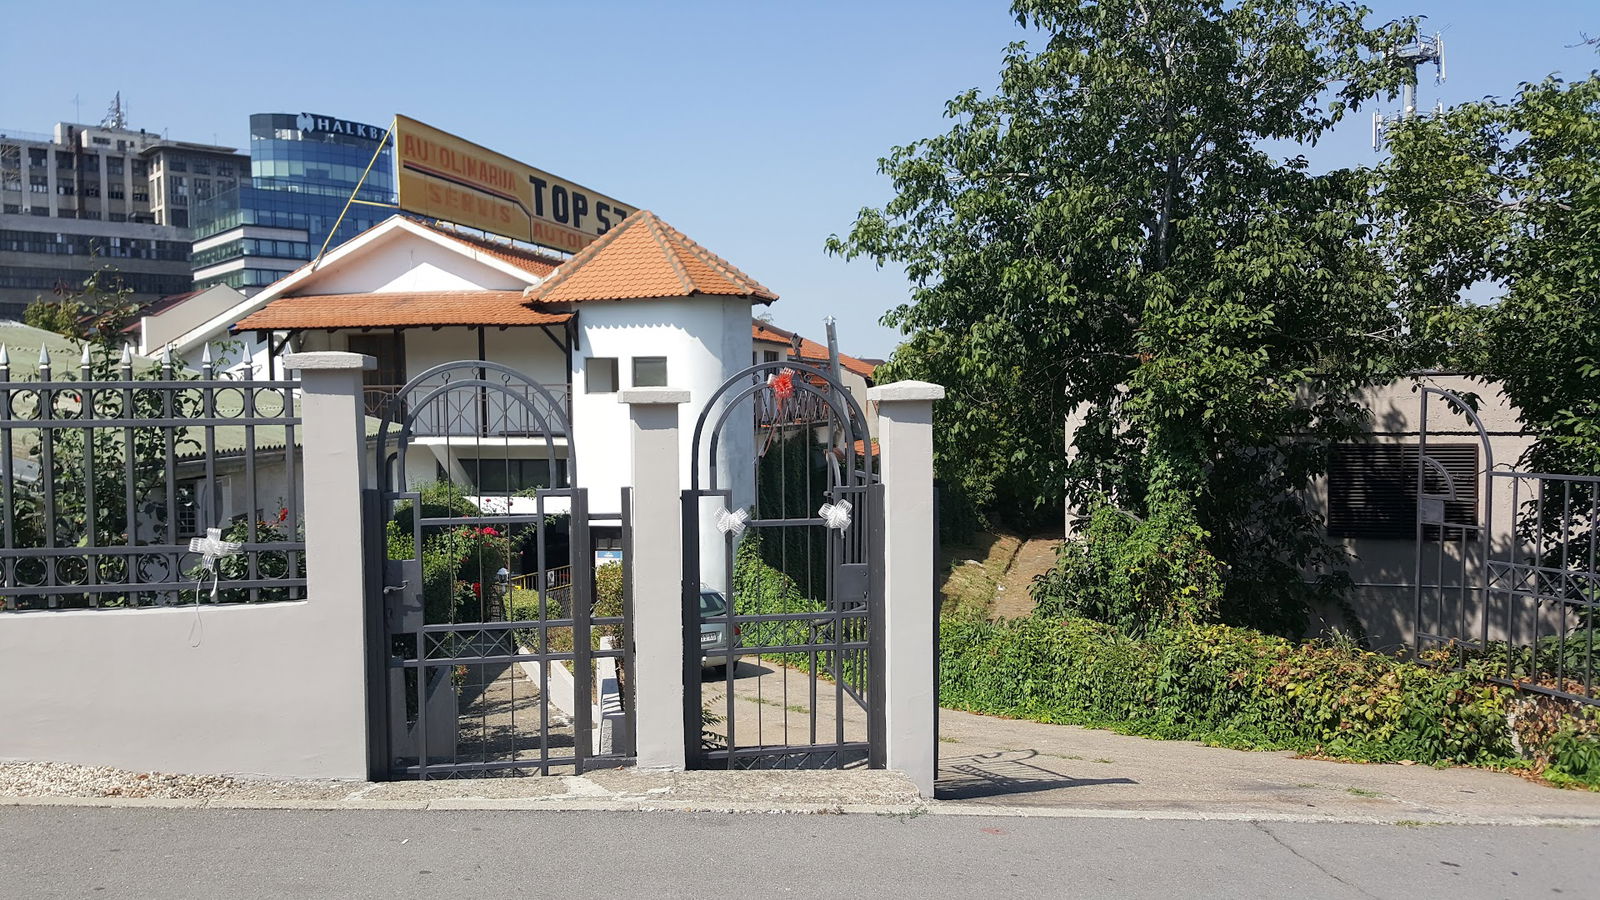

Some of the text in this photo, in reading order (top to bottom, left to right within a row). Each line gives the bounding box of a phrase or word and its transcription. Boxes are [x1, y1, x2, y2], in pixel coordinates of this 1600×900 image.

[429, 183, 511, 223] SERVIS
[529, 175, 589, 229] TOP
[533, 222, 595, 250] AUTOL
